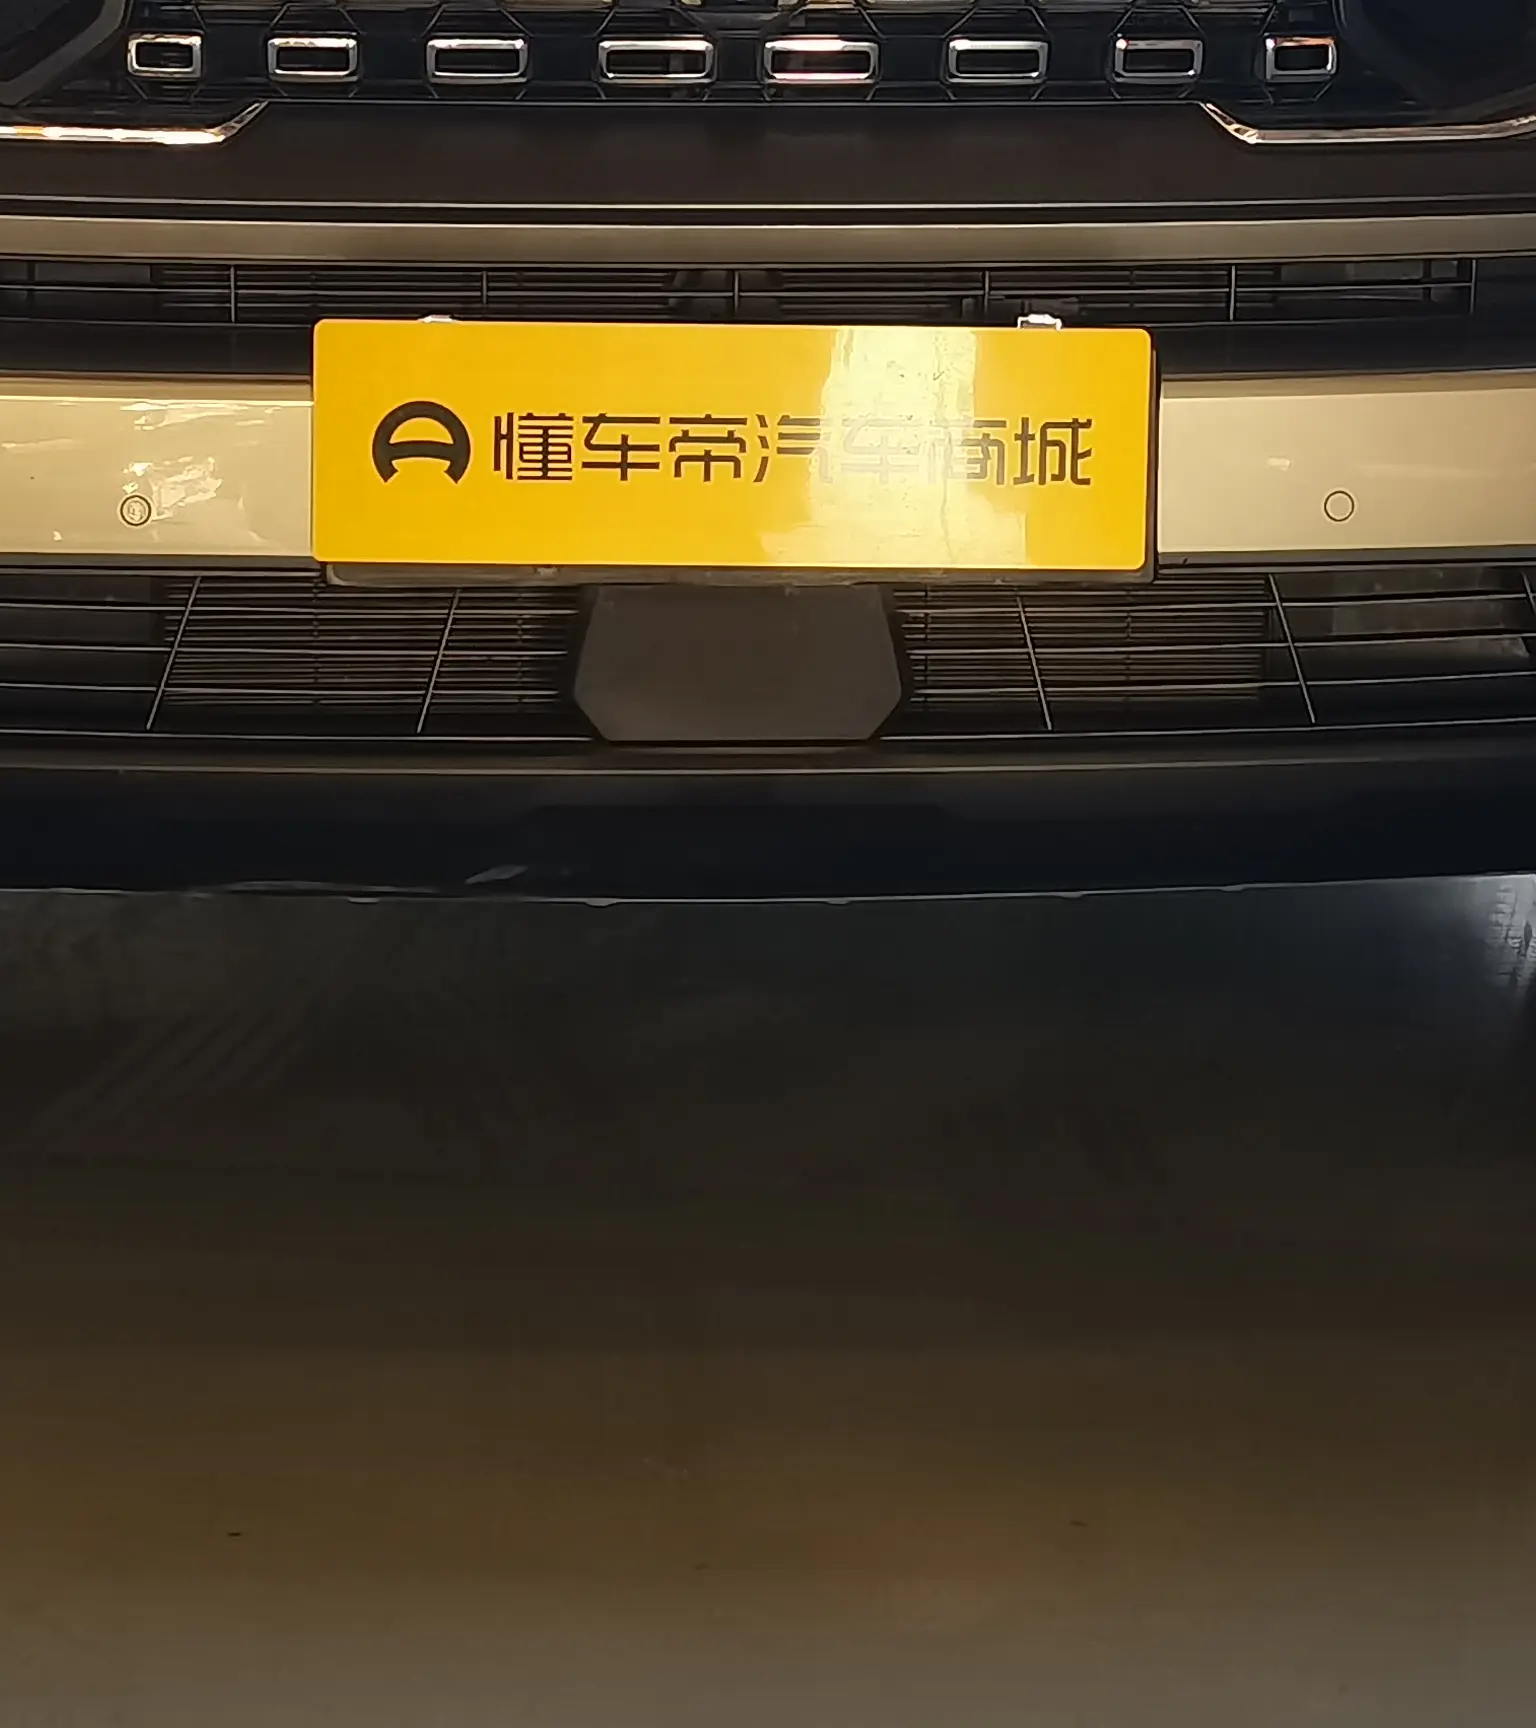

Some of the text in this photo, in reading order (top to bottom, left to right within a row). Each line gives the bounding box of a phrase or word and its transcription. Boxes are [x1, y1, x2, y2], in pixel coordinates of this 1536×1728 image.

[491, 410, 1093, 486] 懂车帝汽车商城
